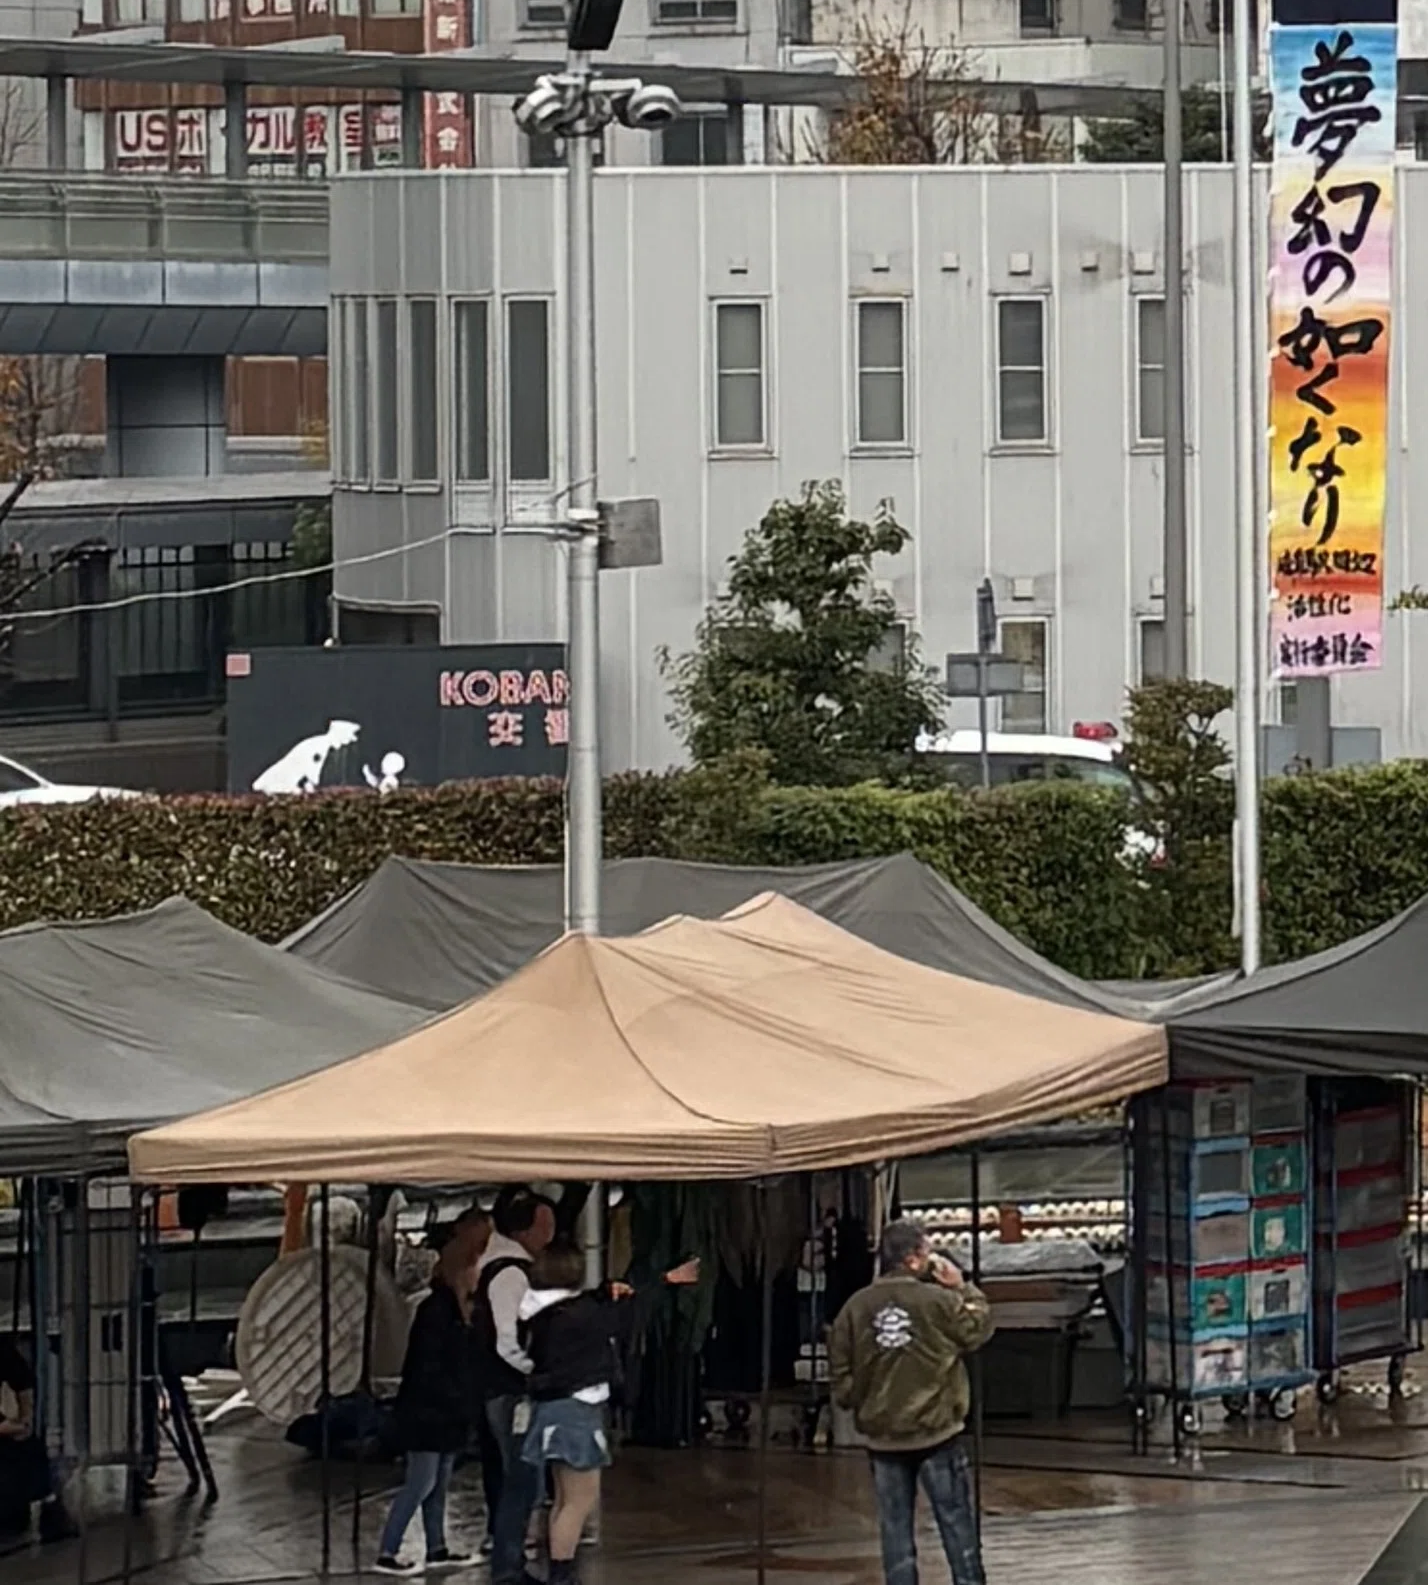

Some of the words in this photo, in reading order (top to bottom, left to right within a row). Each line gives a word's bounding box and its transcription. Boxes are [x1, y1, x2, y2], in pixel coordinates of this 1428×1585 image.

[1278, 31, 1384, 546] 夢幻の如くなり
